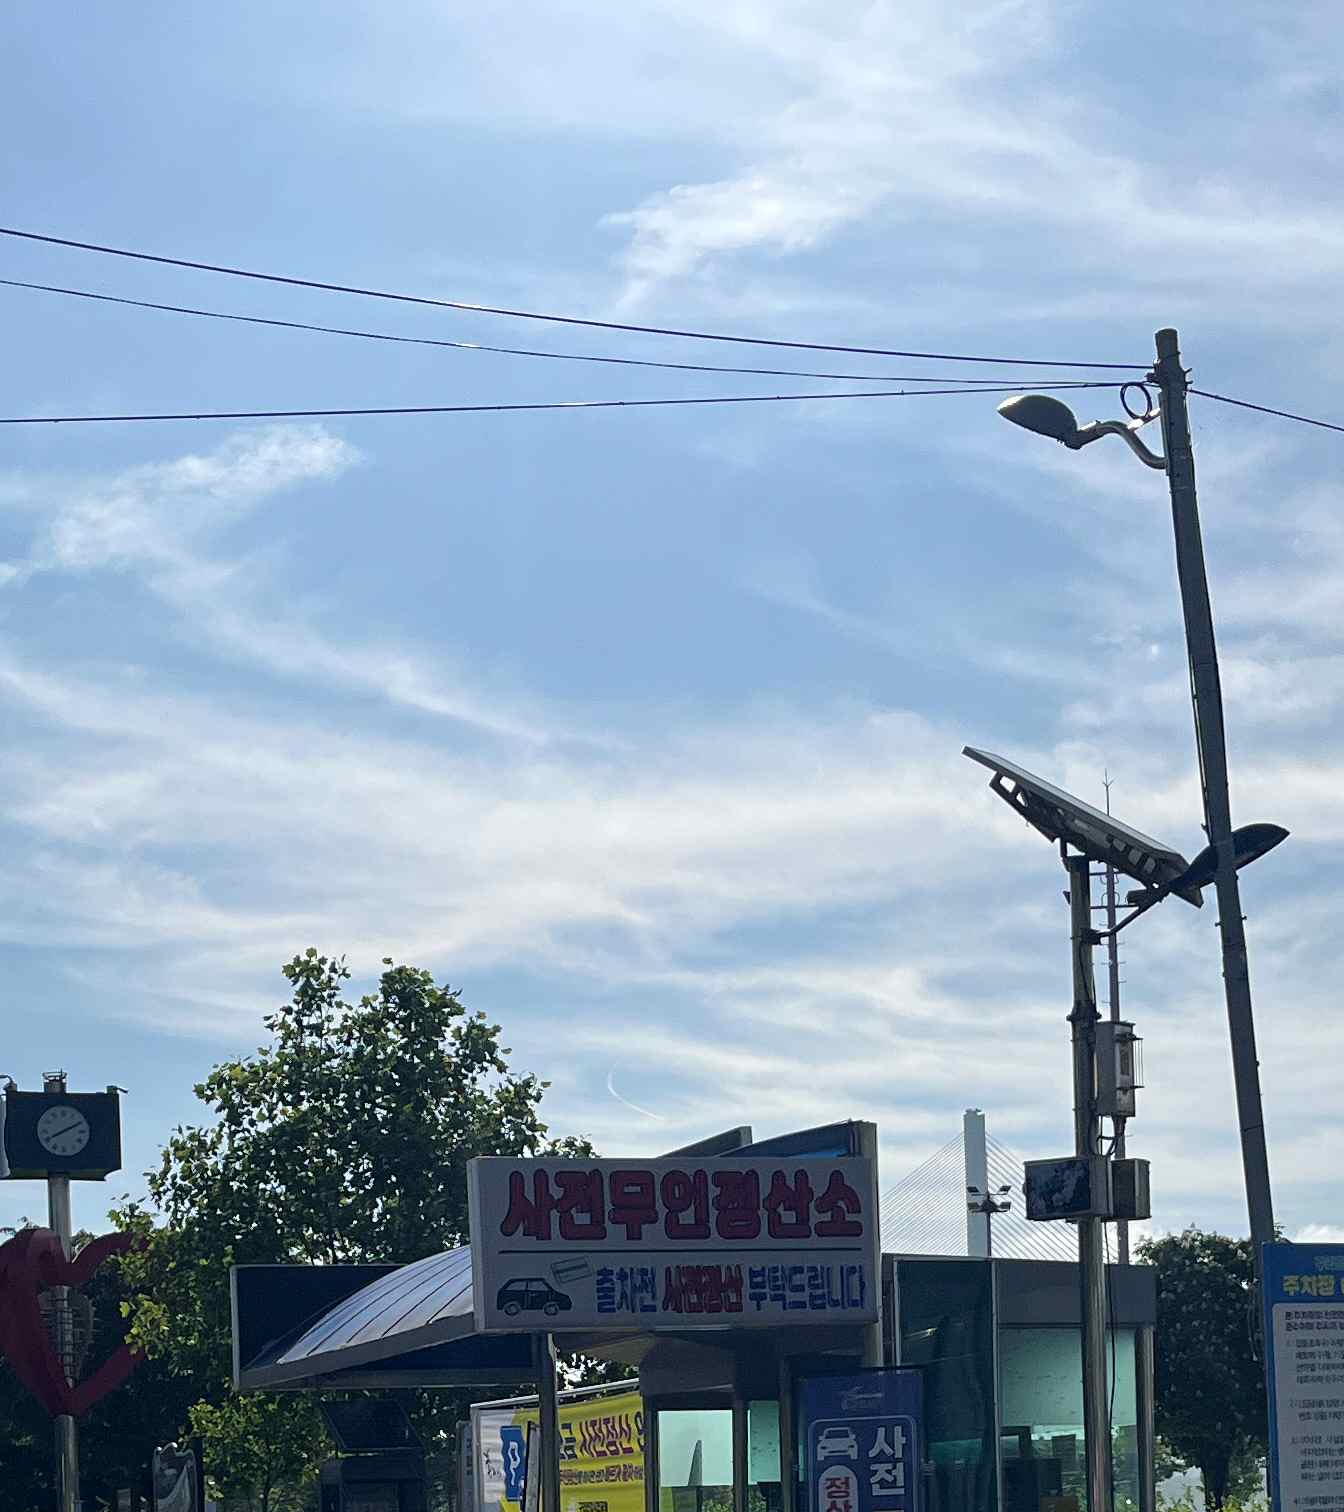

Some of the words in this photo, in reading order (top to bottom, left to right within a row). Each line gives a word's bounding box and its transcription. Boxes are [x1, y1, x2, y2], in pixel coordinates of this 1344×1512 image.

[500, 1167, 864, 1242] 사전무인정산소
[747, 1262, 866, 1312] 부탁드립니다
[867, 1424, 907, 1497] 사전
